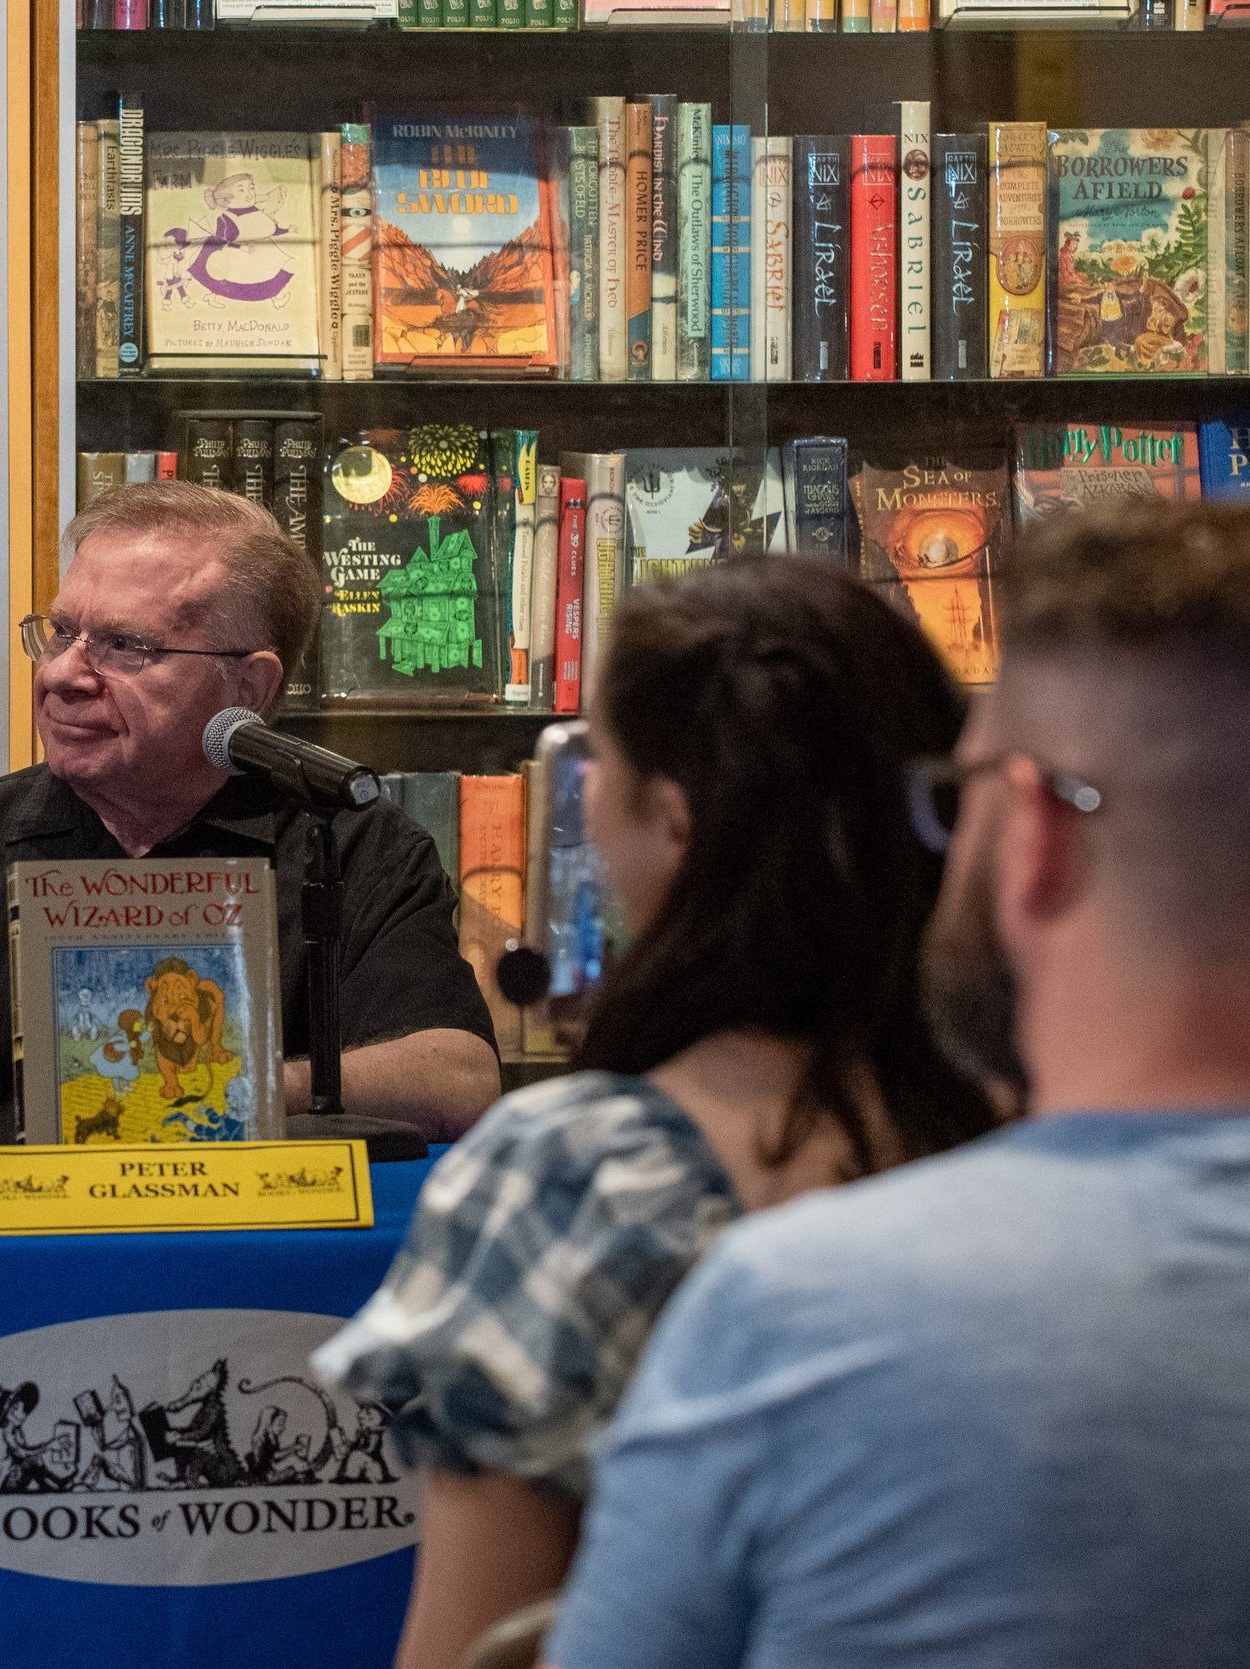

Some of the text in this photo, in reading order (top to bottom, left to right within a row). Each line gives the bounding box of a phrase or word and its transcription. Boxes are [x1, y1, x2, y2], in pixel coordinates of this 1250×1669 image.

[392, 124, 517, 139] ROBIN McKINLEY
[904, 133, 928, 144] NIX
[120, 108, 144, 216] DRAGONDRUMS
[1055, 154, 1189, 178] BORROWERS
[106, 145, 118, 210] Earthfasts
[418, 167, 490, 189] BLUE
[1071, 179, 1164, 201] AFIELD
[397, 192, 519, 215] SWORD
[1234, 172, 1246, 233] BORROWERS
[635, 170, 648, 271] HOMER PRICE
[124, 225, 135, 262] ANNE
[690, 172, 703, 332] The Outlaws Sherwood
[328, 198, 340, 321] Mrs. Piggle-Wiggle
[1025, 423, 1185, 468] Harry Potter
[803, 463, 839, 472] RIORDAN
[811, 457, 831, 465] RICK
[289, 464, 308, 502] THE
[901, 465, 951, 490] SEA
[348, 537, 377, 552] THE
[323, 547, 402, 567] WESTING
[570, 551, 578, 577] CLUES
[330, 566, 382, 588] GAME
[335, 589, 381, 602] ELLEN
[329, 602, 382, 618] RASKIN
[565, 603, 573, 634] RISING
[572, 598, 580, 640] VESPERS
[25, 867, 260, 898] The WONDERFUL
[43, 900, 244, 929] WIZARD of OZ
[119, 1161, 208, 1177] PETER
[89, 1182, 240, 1199] GLASSMAN
[151, 1511, 170, 1531] of
